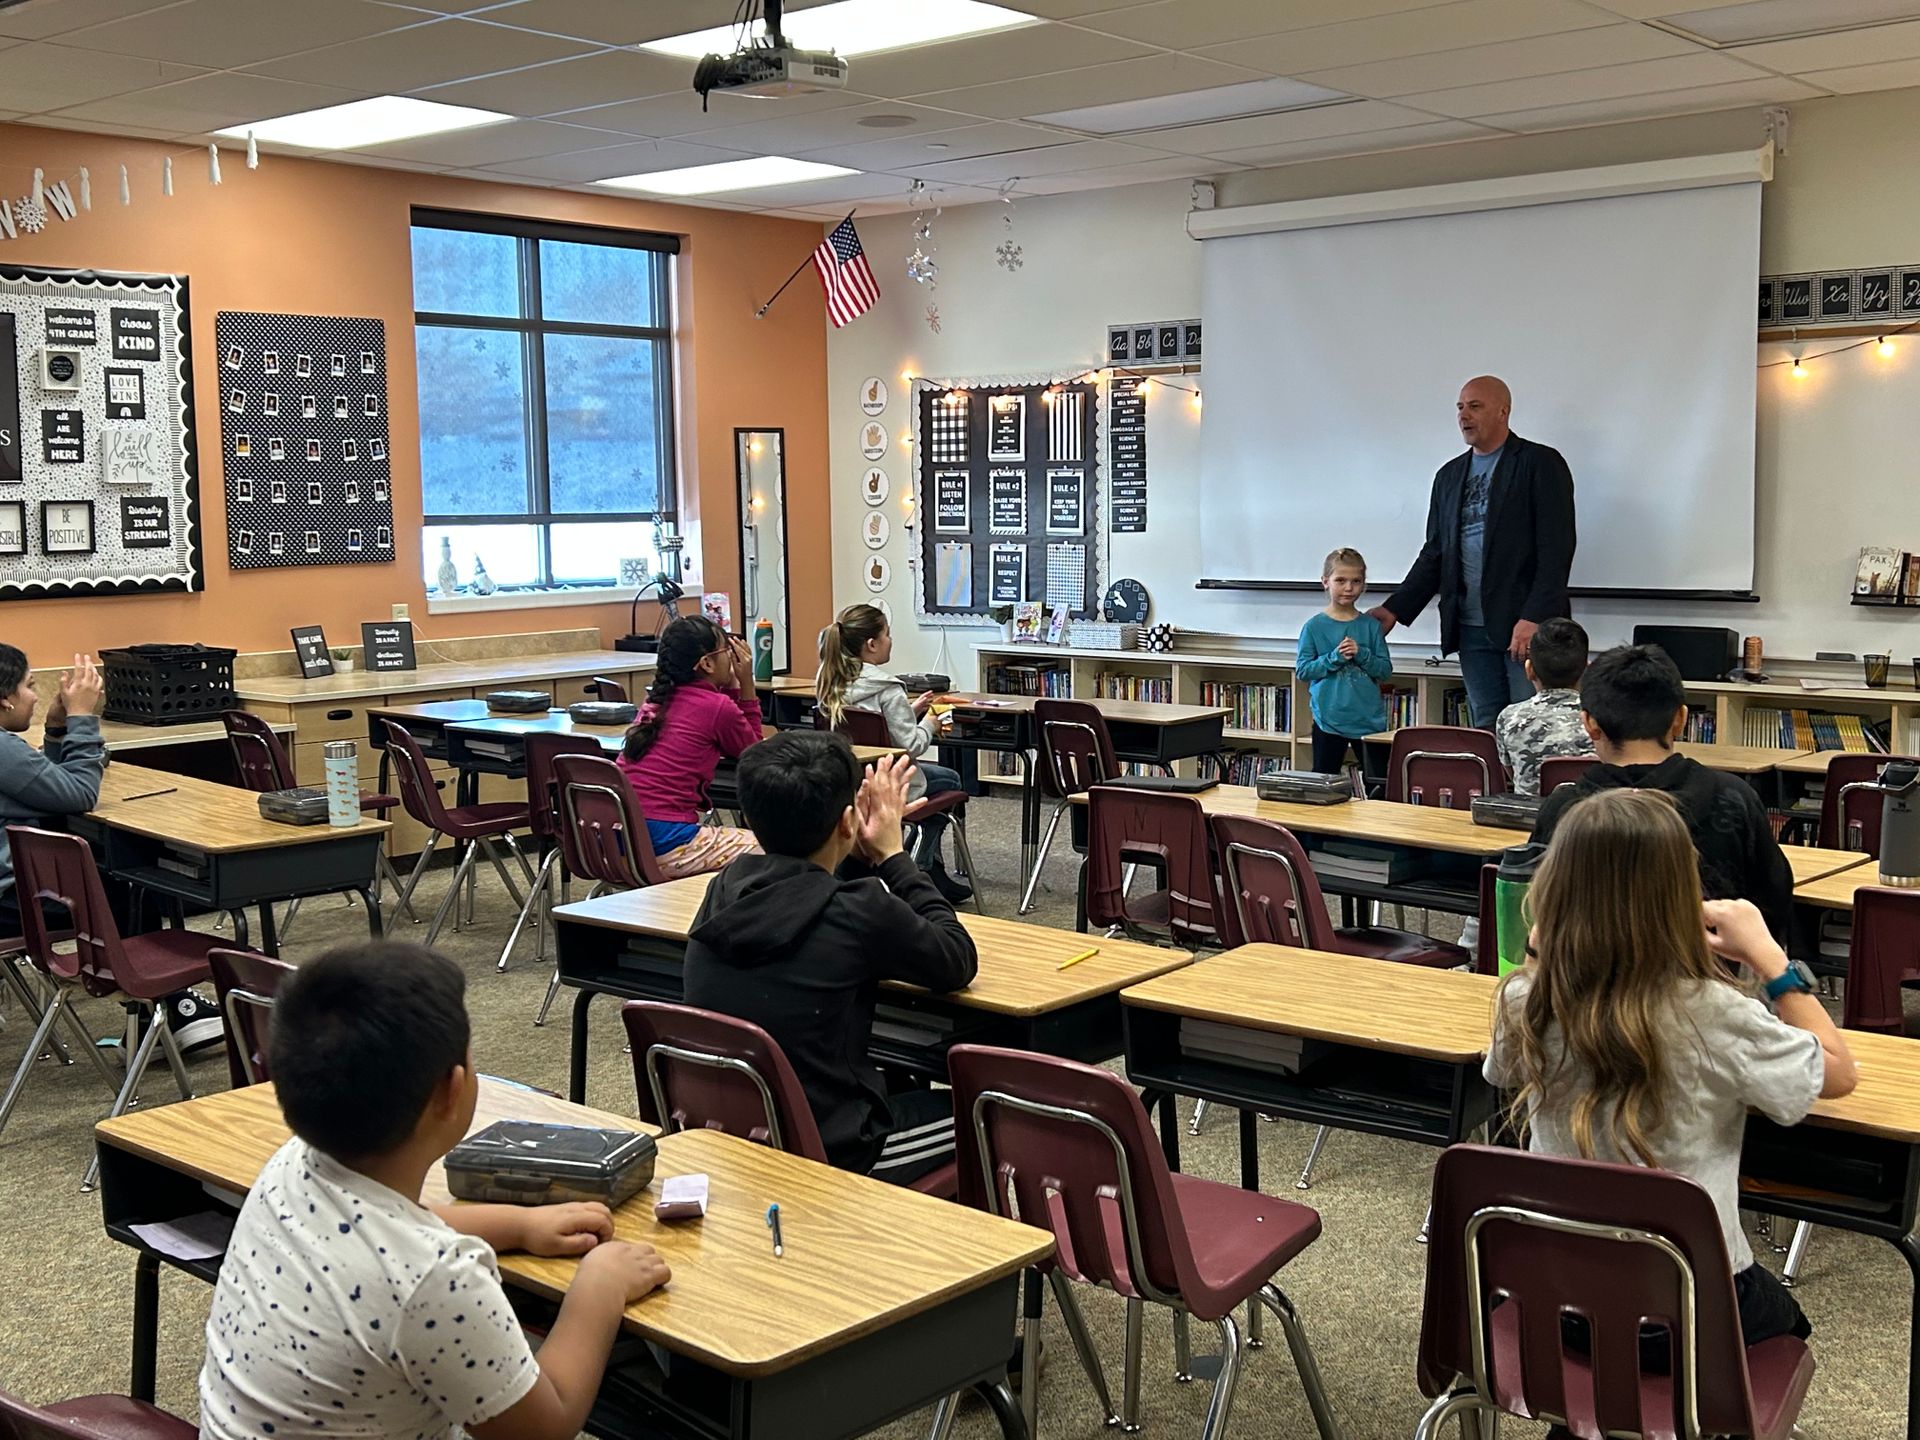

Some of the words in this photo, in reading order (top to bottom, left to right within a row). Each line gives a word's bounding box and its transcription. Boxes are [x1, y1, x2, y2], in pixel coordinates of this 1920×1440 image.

[1863, 282, 1890, 309] Yy
[48, 314, 83, 326] welcome
[83, 316, 93, 326] to
[120, 317, 153, 330] choose
[48, 329, 66, 338] 4TH
[67, 330, 95, 339] GRADE
[118, 336, 156, 350] KIND
[1111, 336, 1128, 351] Aa
[1136, 334, 1152, 350] Bb
[112, 377, 138, 387] LOVE
[112, 391, 139, 401] WINS
[56, 412, 69, 421] all
[56, 424, 71, 433] ARE
[47, 435, 81, 445] welcome
[51, 449, 79, 460] HERE
[941, 481, 956, 489] RULE
[1053, 484, 1069, 492] RULE
[62, 508, 71, 523] BE
[133, 519, 143, 527] IS
[143, 519, 158, 527] OUR
[48, 529, 86, 544] POSITIVE
[124, 530, 169, 540] STRENGTH
[1870, 555, 1887, 564] PAX
[759, 635, 773, 651] G
